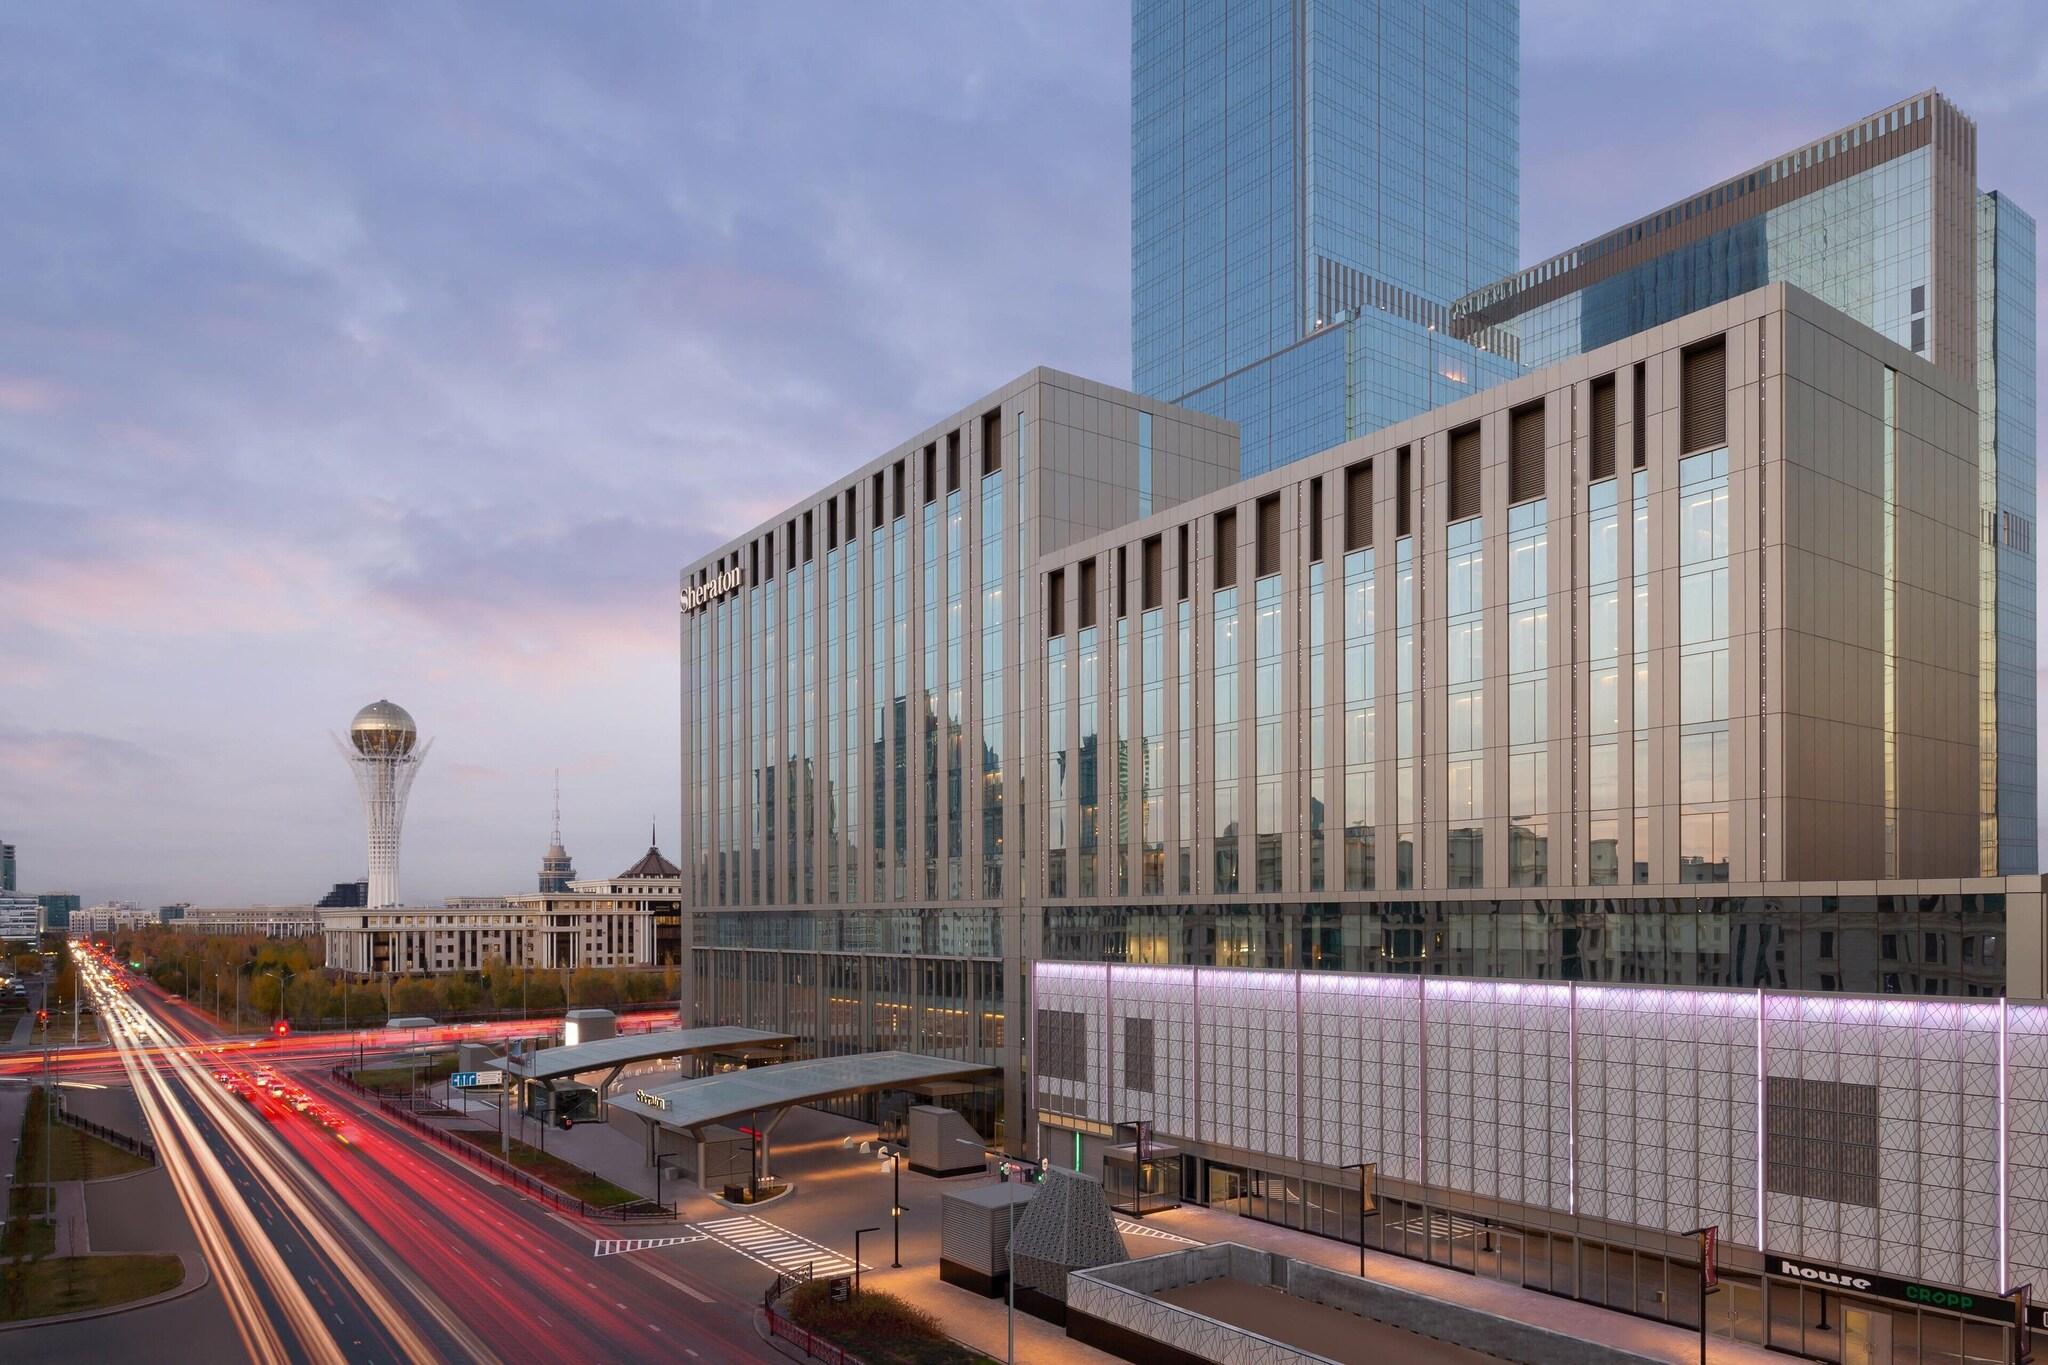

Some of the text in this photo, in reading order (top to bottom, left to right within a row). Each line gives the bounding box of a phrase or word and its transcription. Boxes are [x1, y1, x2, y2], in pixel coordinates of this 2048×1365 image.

[680, 567, 741, 613] Sheraton
[1782, 1261, 1872, 1290] house
[1906, 1286, 1973, 1309] CROPP
